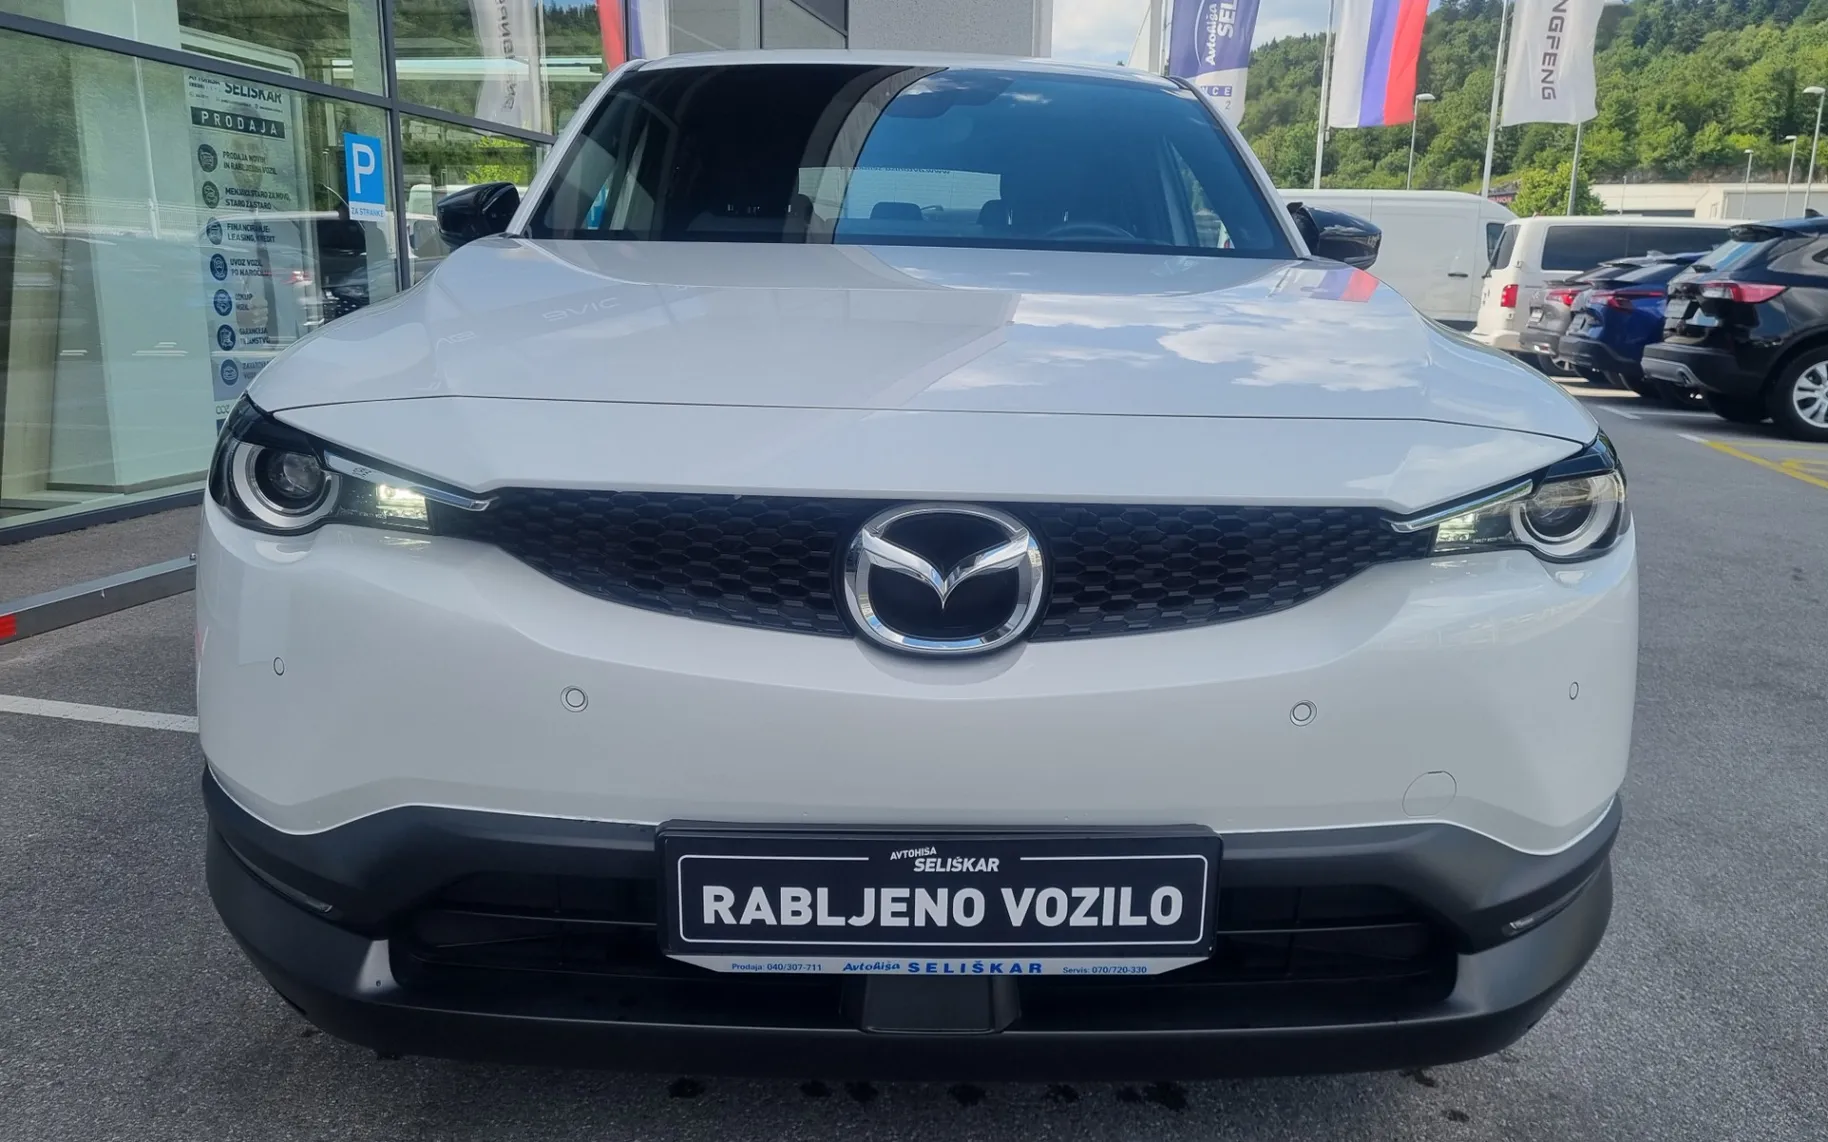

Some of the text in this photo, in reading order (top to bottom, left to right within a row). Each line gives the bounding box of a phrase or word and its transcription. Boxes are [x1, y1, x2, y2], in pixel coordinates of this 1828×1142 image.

[1540, 0, 1569, 100] NGFENG
[201, 110, 278, 136] PRODAJA
[351, 142, 375, 194] P
[229, 257, 246, 266] UVOZ
[913, 856, 1000, 872] SELIŠKAR
[702, 885, 1184, 927] RABLJENO VOZILO
[731, 960, 1147, 974] Prodaja: 040/307-711 Avtohiša SELIŠKAR Servis: 070/720-330
